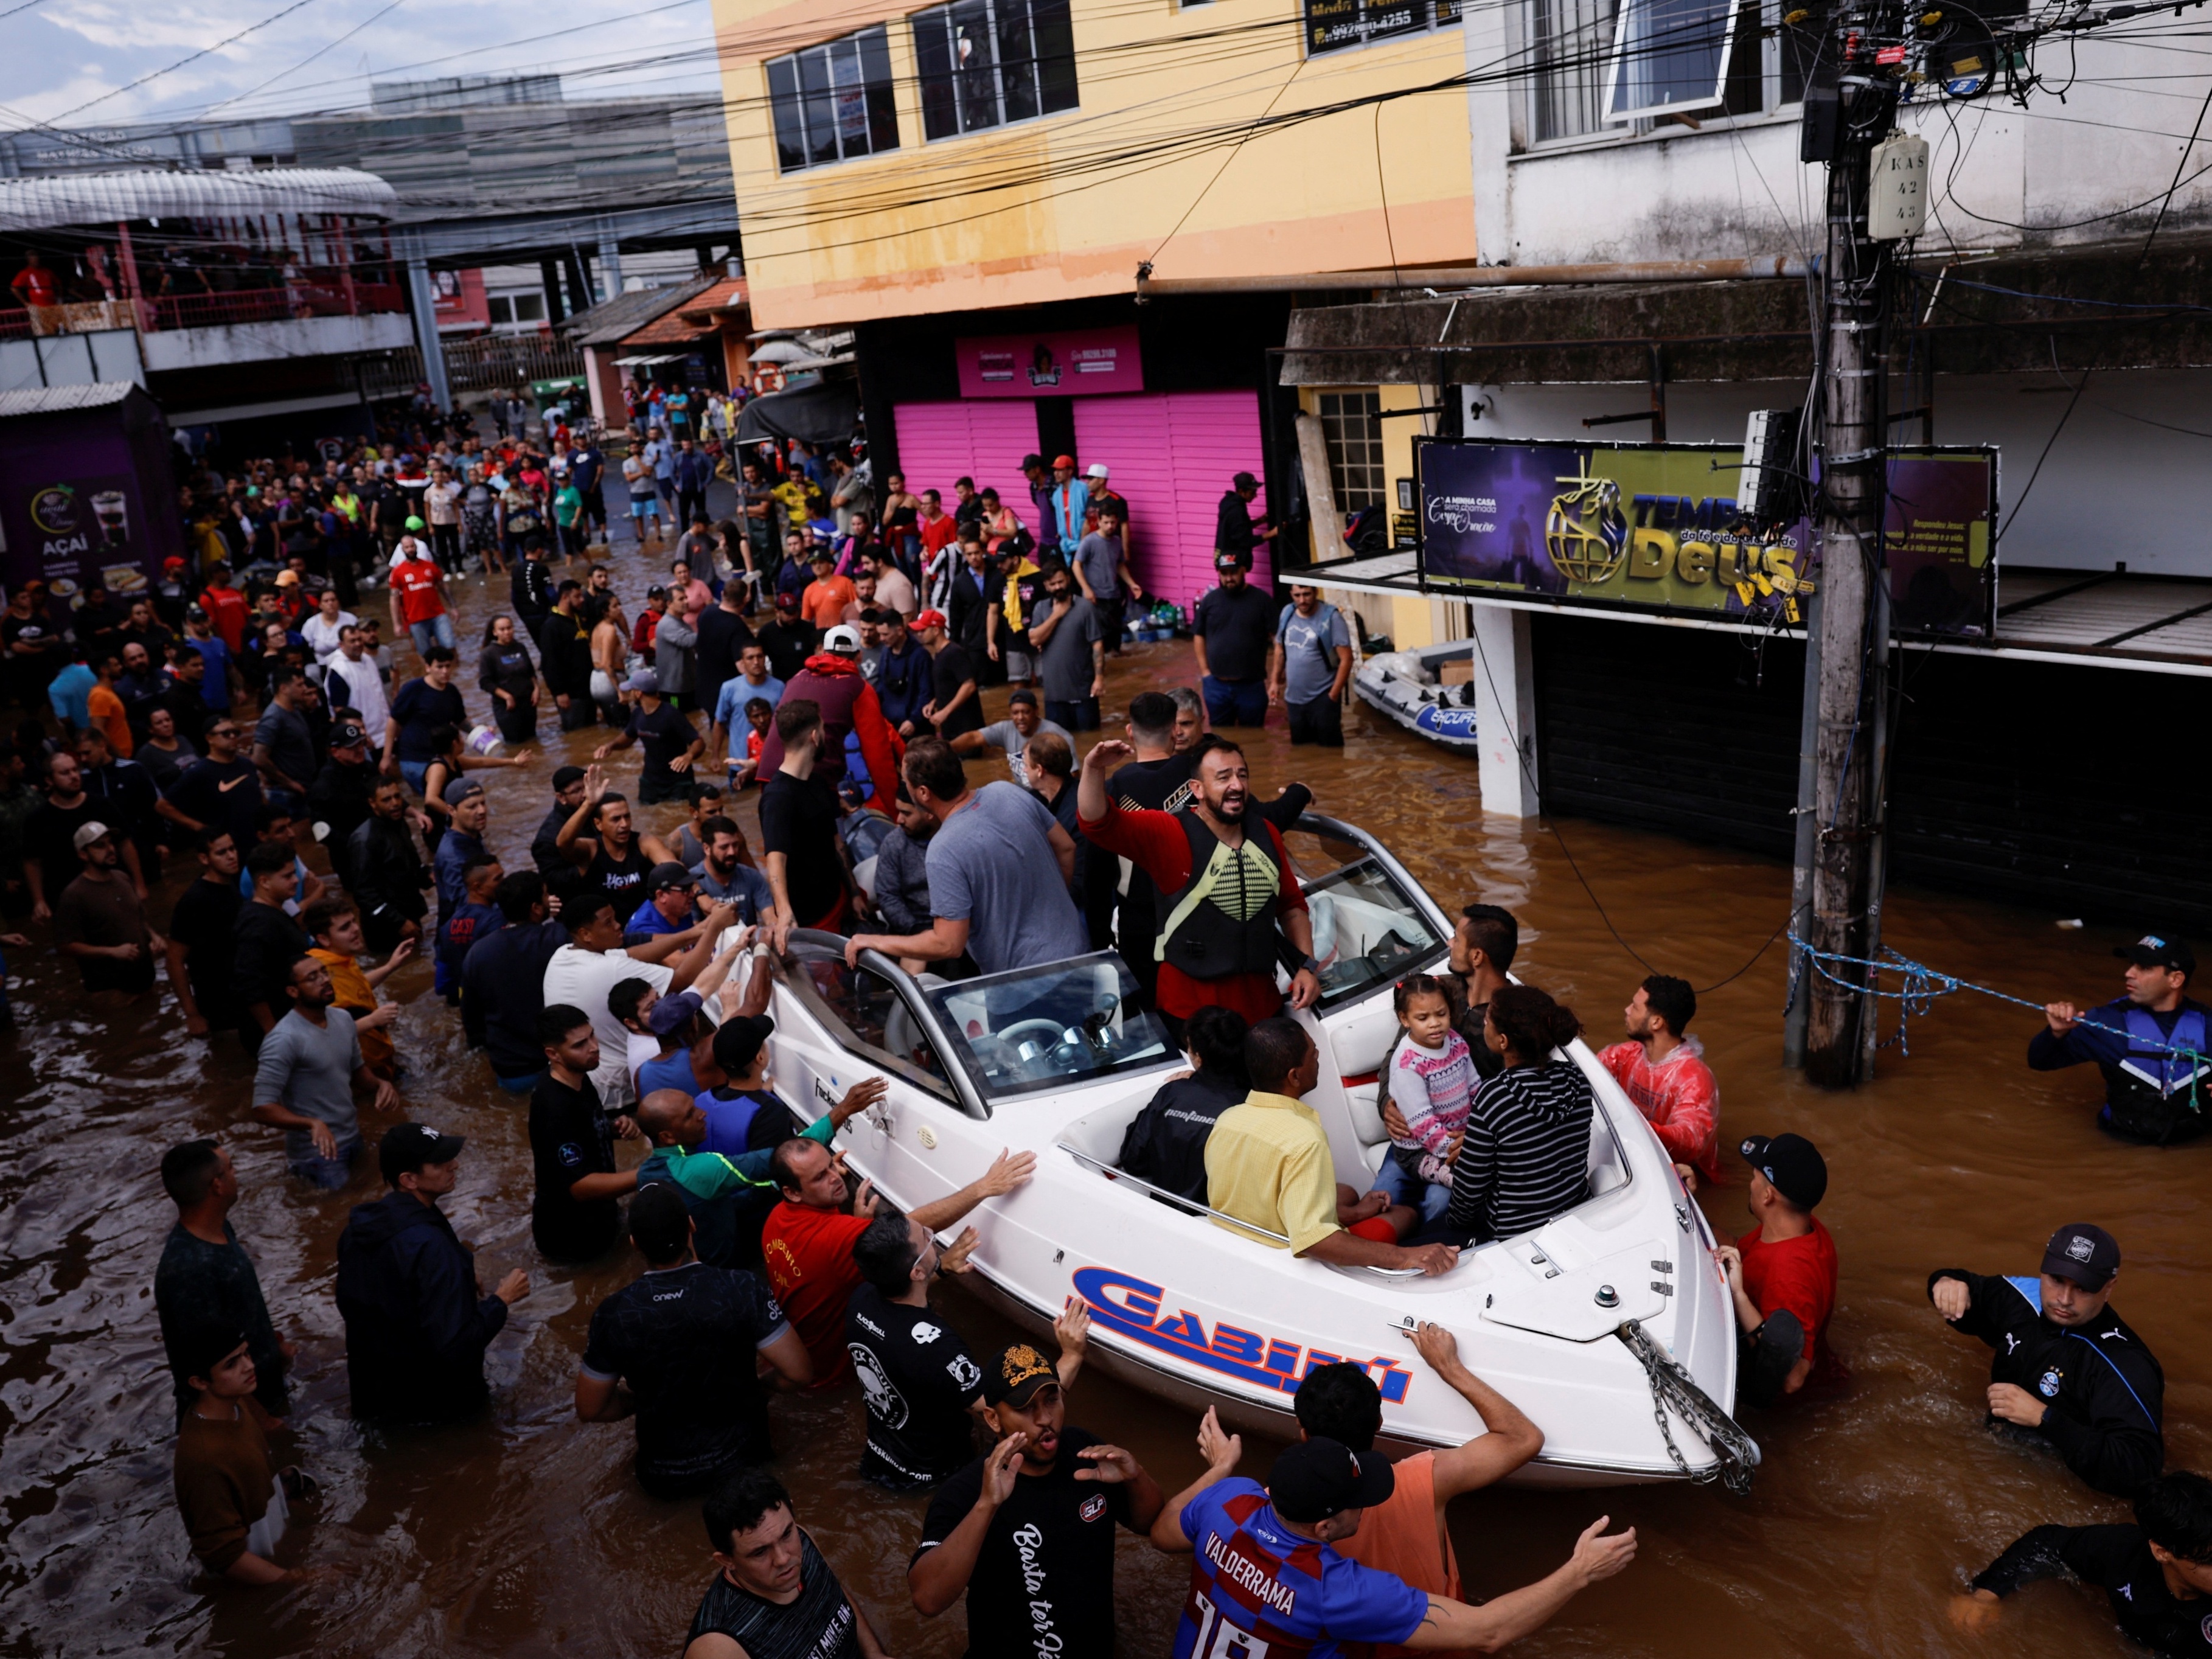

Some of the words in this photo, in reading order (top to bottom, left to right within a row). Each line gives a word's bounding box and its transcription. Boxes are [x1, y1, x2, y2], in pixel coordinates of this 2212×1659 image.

[1891, 155, 1924, 170] KAS
[1898, 181, 1917, 194] 42
[1897, 206, 1915, 218] 43
[1452, 496, 1475, 505] MINHA
[1476, 498, 1496, 506] CASA
[43, 532, 89, 557] AÇAÍ
[868, 1357, 897, 1403] SKULL
[1009, 1366, 1052, 1386] SCANIA
[1085, 1498, 1103, 1517] GLP
[1013, 1523, 1046, 1595] Basta
[1205, 1531, 1295, 1615] VALDERRAMA
[1029, 1600, 1054, 1633] ter
[819, 1618, 843, 1653] MOVE
